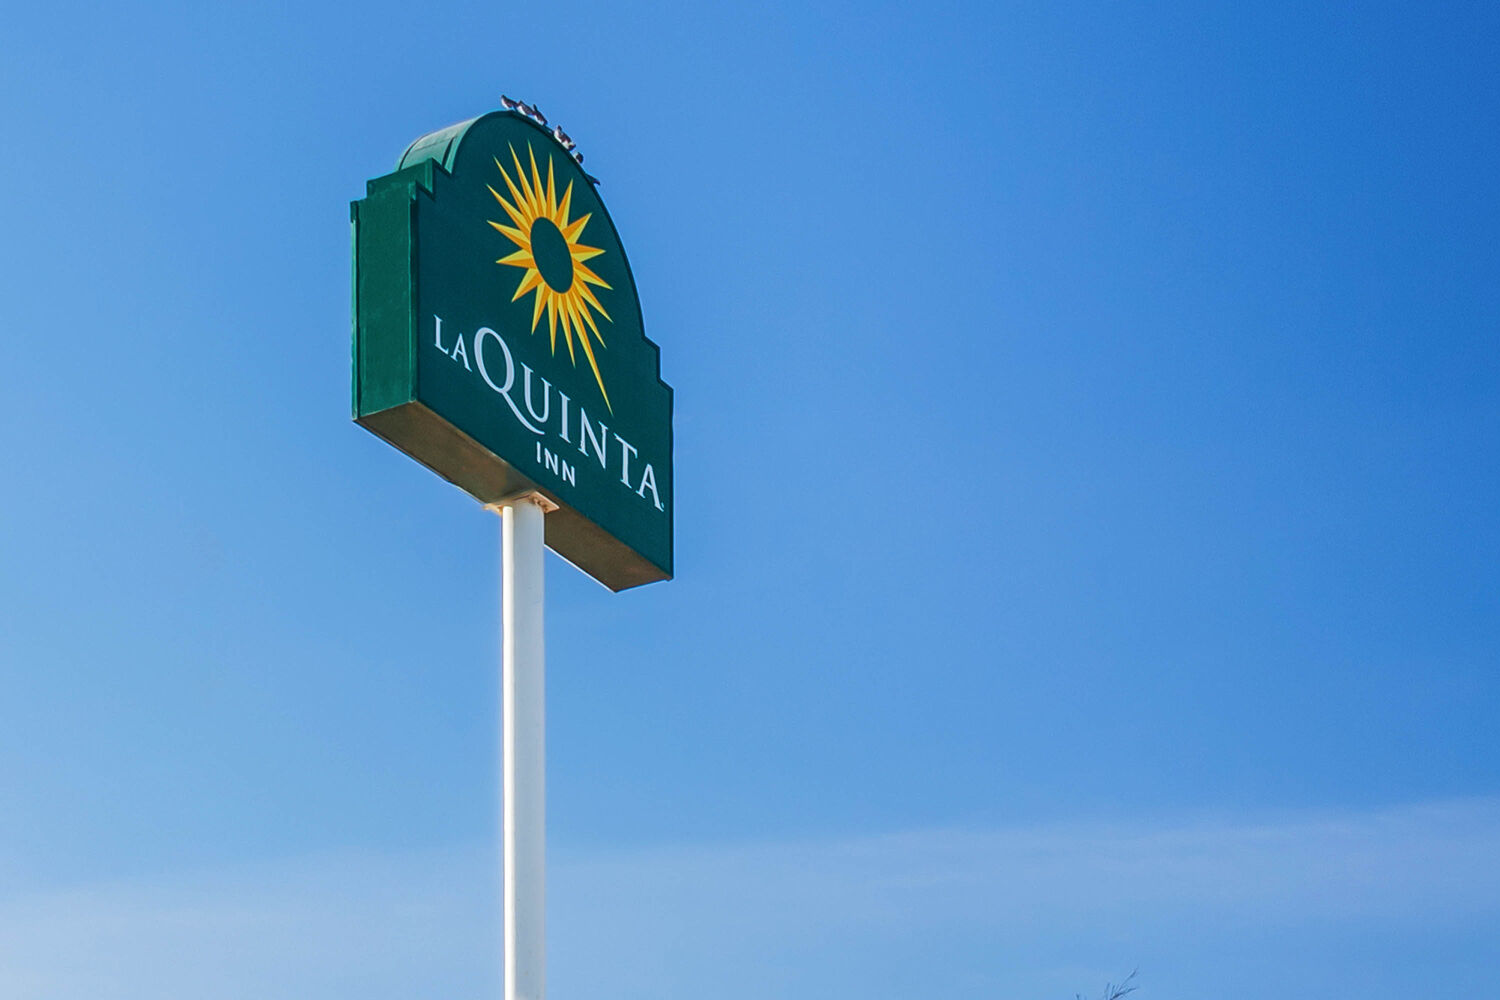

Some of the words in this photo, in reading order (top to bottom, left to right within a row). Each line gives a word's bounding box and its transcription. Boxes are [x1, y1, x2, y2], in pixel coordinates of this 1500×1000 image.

[433, 314, 472, 372] LA
[474, 327, 664, 512] QUINTA
[536, 441, 576, 487] INN
